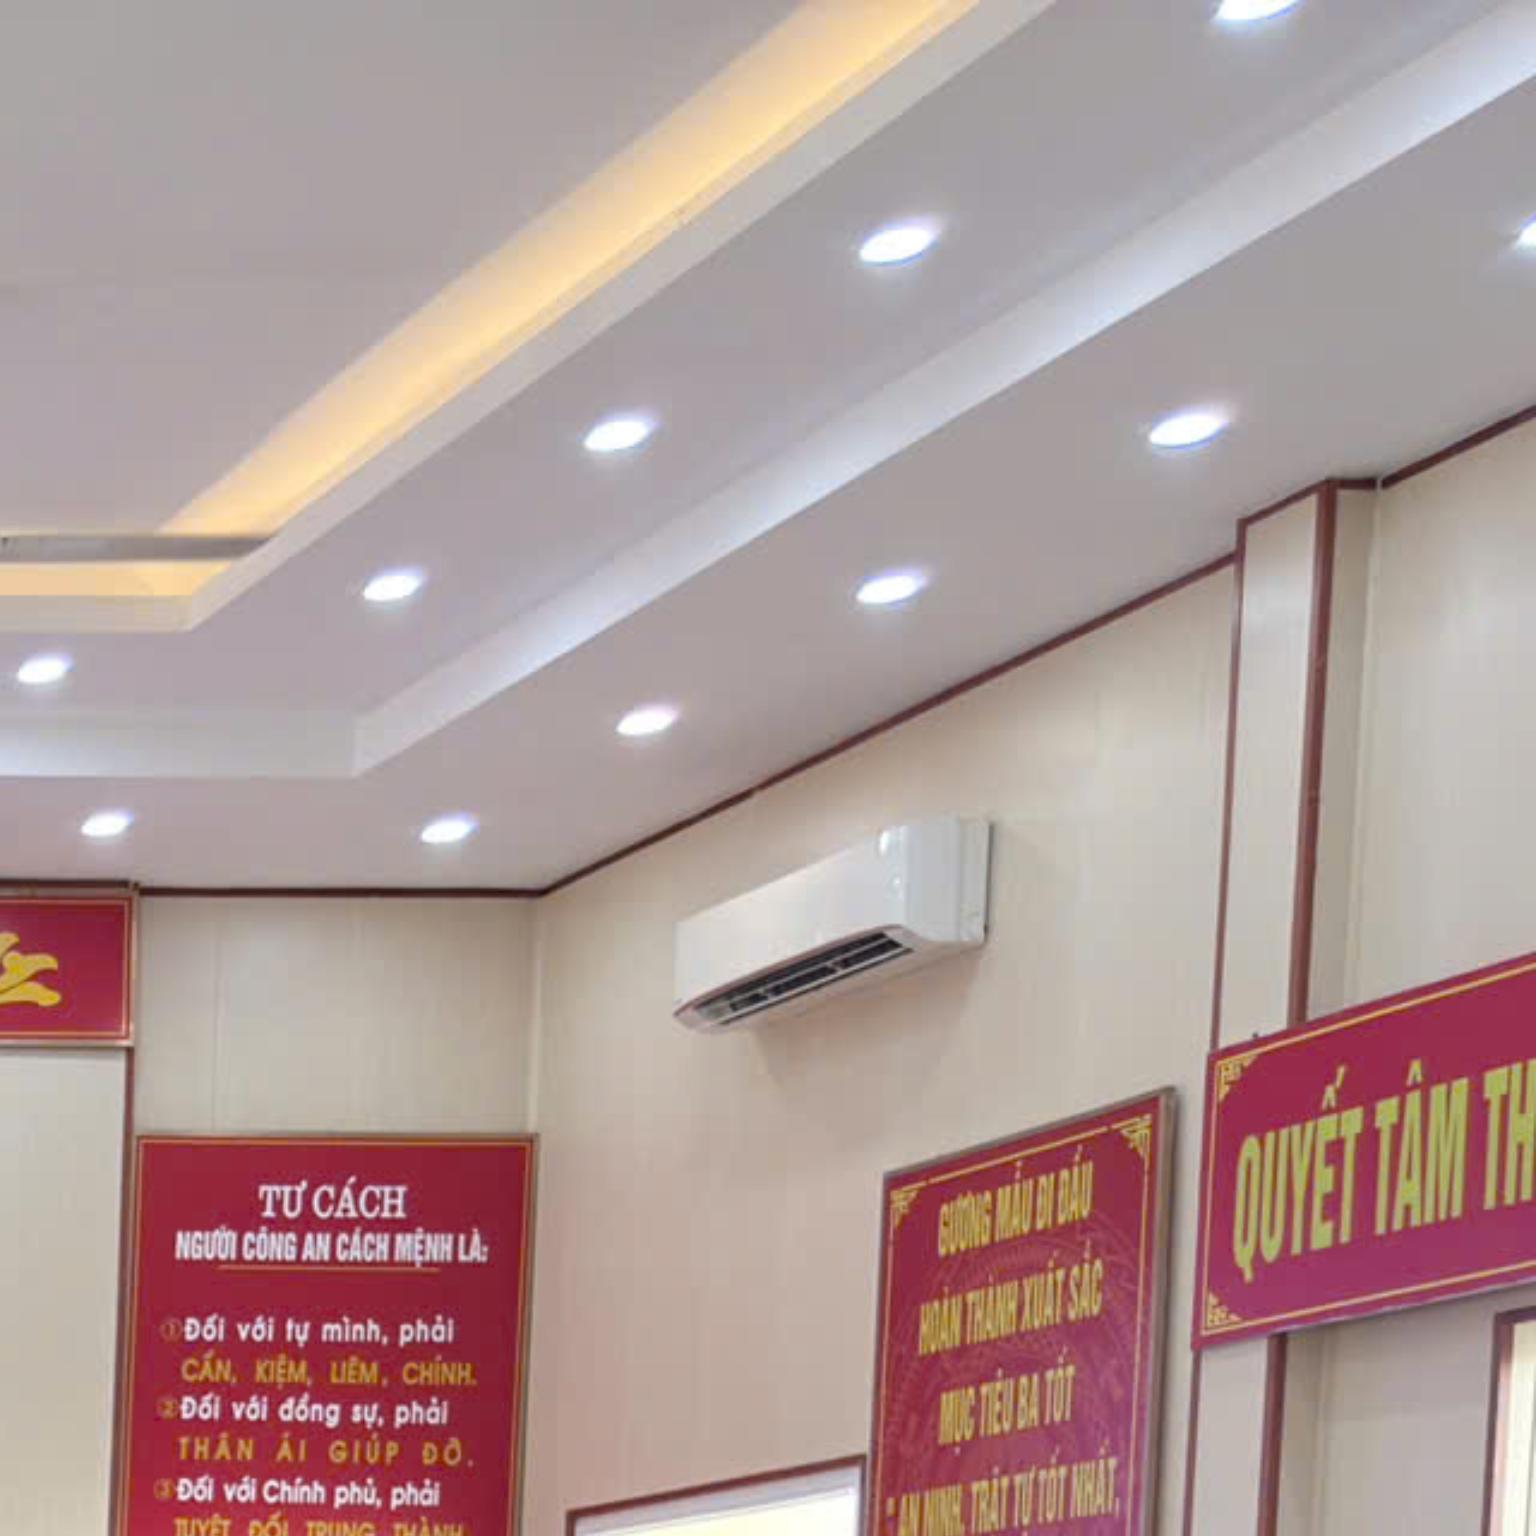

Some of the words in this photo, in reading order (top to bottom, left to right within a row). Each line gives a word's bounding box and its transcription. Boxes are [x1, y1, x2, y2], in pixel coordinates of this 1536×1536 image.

[1234, 1065, 1364, 1283] QUYẾT
[1375, 1058, 1469, 1235] TÂM
[258, 1180, 308, 1218] TƯ
[312, 1176, 407, 1218] CÁCH
[175, 1225, 237, 1260] NGƯỜI
[243, 1226, 296, 1260] CÔNG
[302, 1232, 331, 1261] AN
[336, 1227, 389, 1262] CÁCH
[394, 1228, 452, 1268] MỆNH
[458, 1228, 488, 1262] LÀ:
[966, 1272, 1019, 1344] THÀNH
[1022, 1250, 1065, 1330] XUẤT
[1068, 1238, 1103, 1321] SẮC
[184, 1314, 225, 1341] Đối
[236, 1315, 274, 1341] với
[286, 1318, 309, 1346] tự
[321, 1316, 388, 1345] mình,
[399, 1315, 454, 1346] phải
[177, 1476, 213, 1502] Đối
[223, 1477, 255, 1502] với
[263, 1479, 326, 1503] Chính
[334, 1480, 381, 1509] phủ,
[390, 1479, 441, 1509] phải
